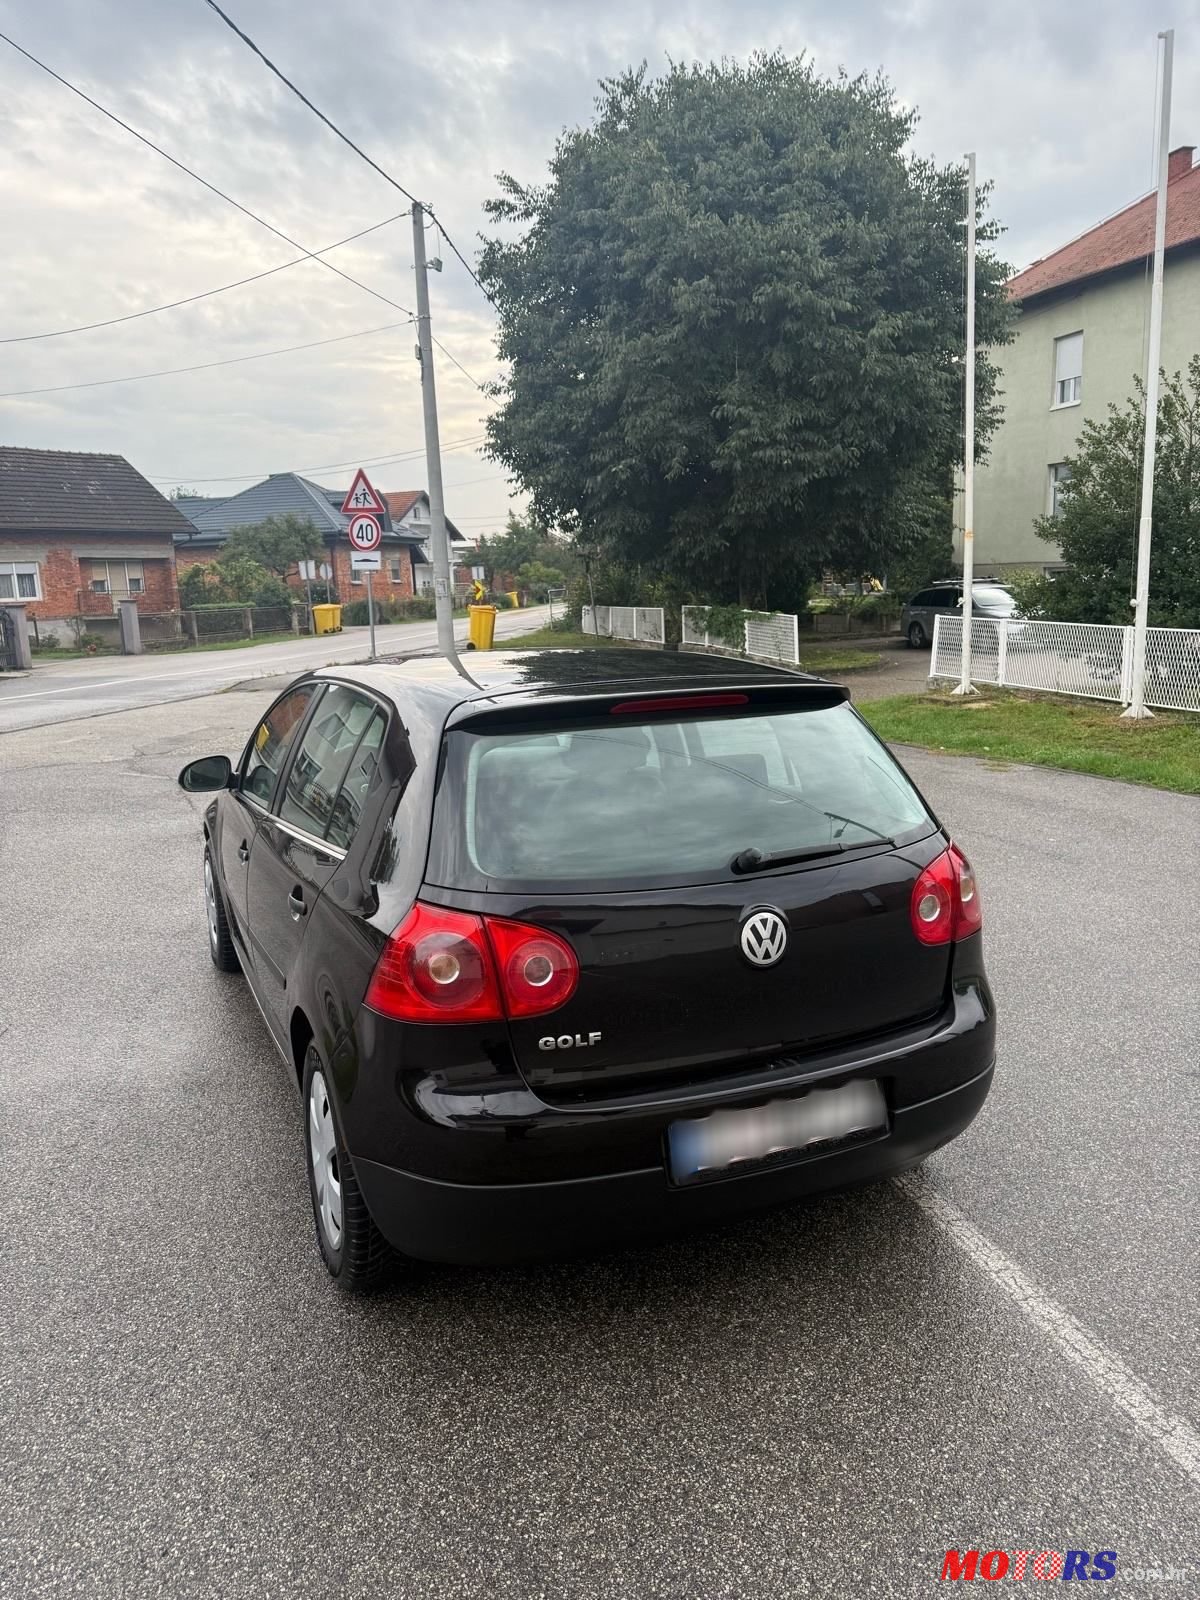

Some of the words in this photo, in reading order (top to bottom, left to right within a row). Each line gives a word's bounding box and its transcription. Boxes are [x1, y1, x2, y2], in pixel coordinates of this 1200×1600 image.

[356, 523, 374, 542] 40
[742, 912, 787, 965] VW
[539, 1031, 602, 1050] GOLF
